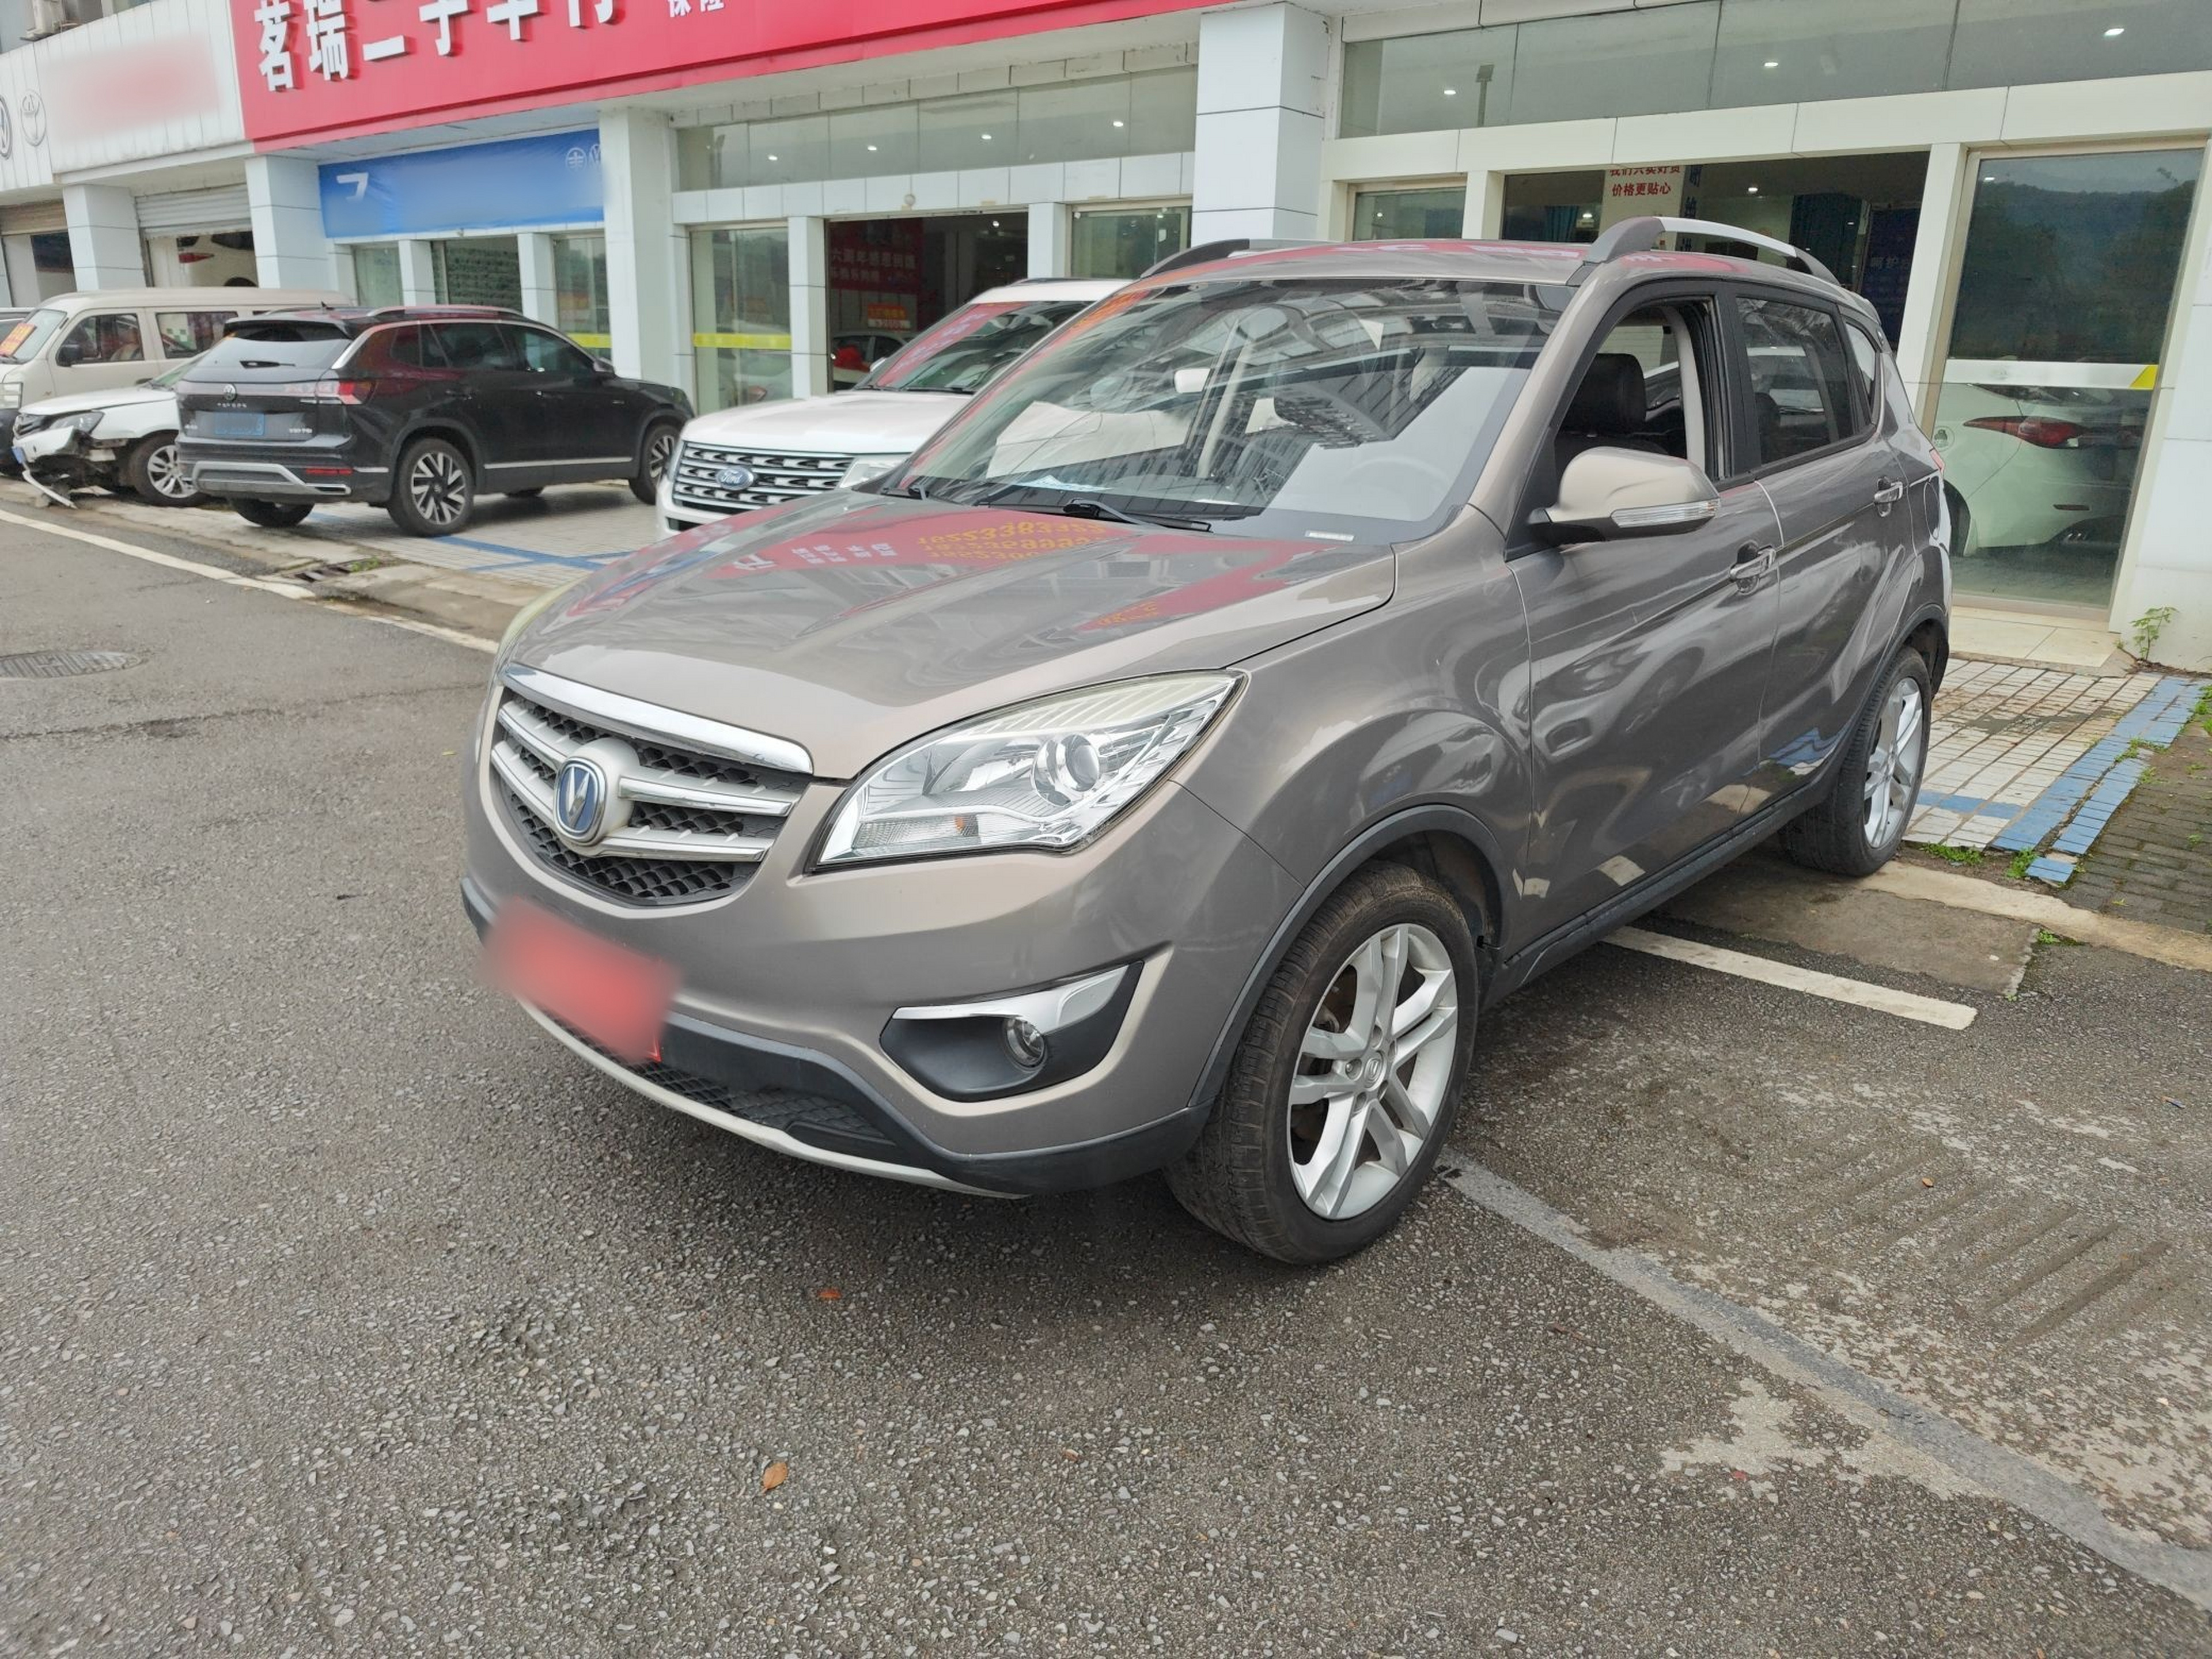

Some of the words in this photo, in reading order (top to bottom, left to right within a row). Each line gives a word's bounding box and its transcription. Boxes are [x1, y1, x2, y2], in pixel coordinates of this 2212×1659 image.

[254, 0, 614, 91] 茗瑞二手
[1612, 182, 1671, 196] 价格更贴心
